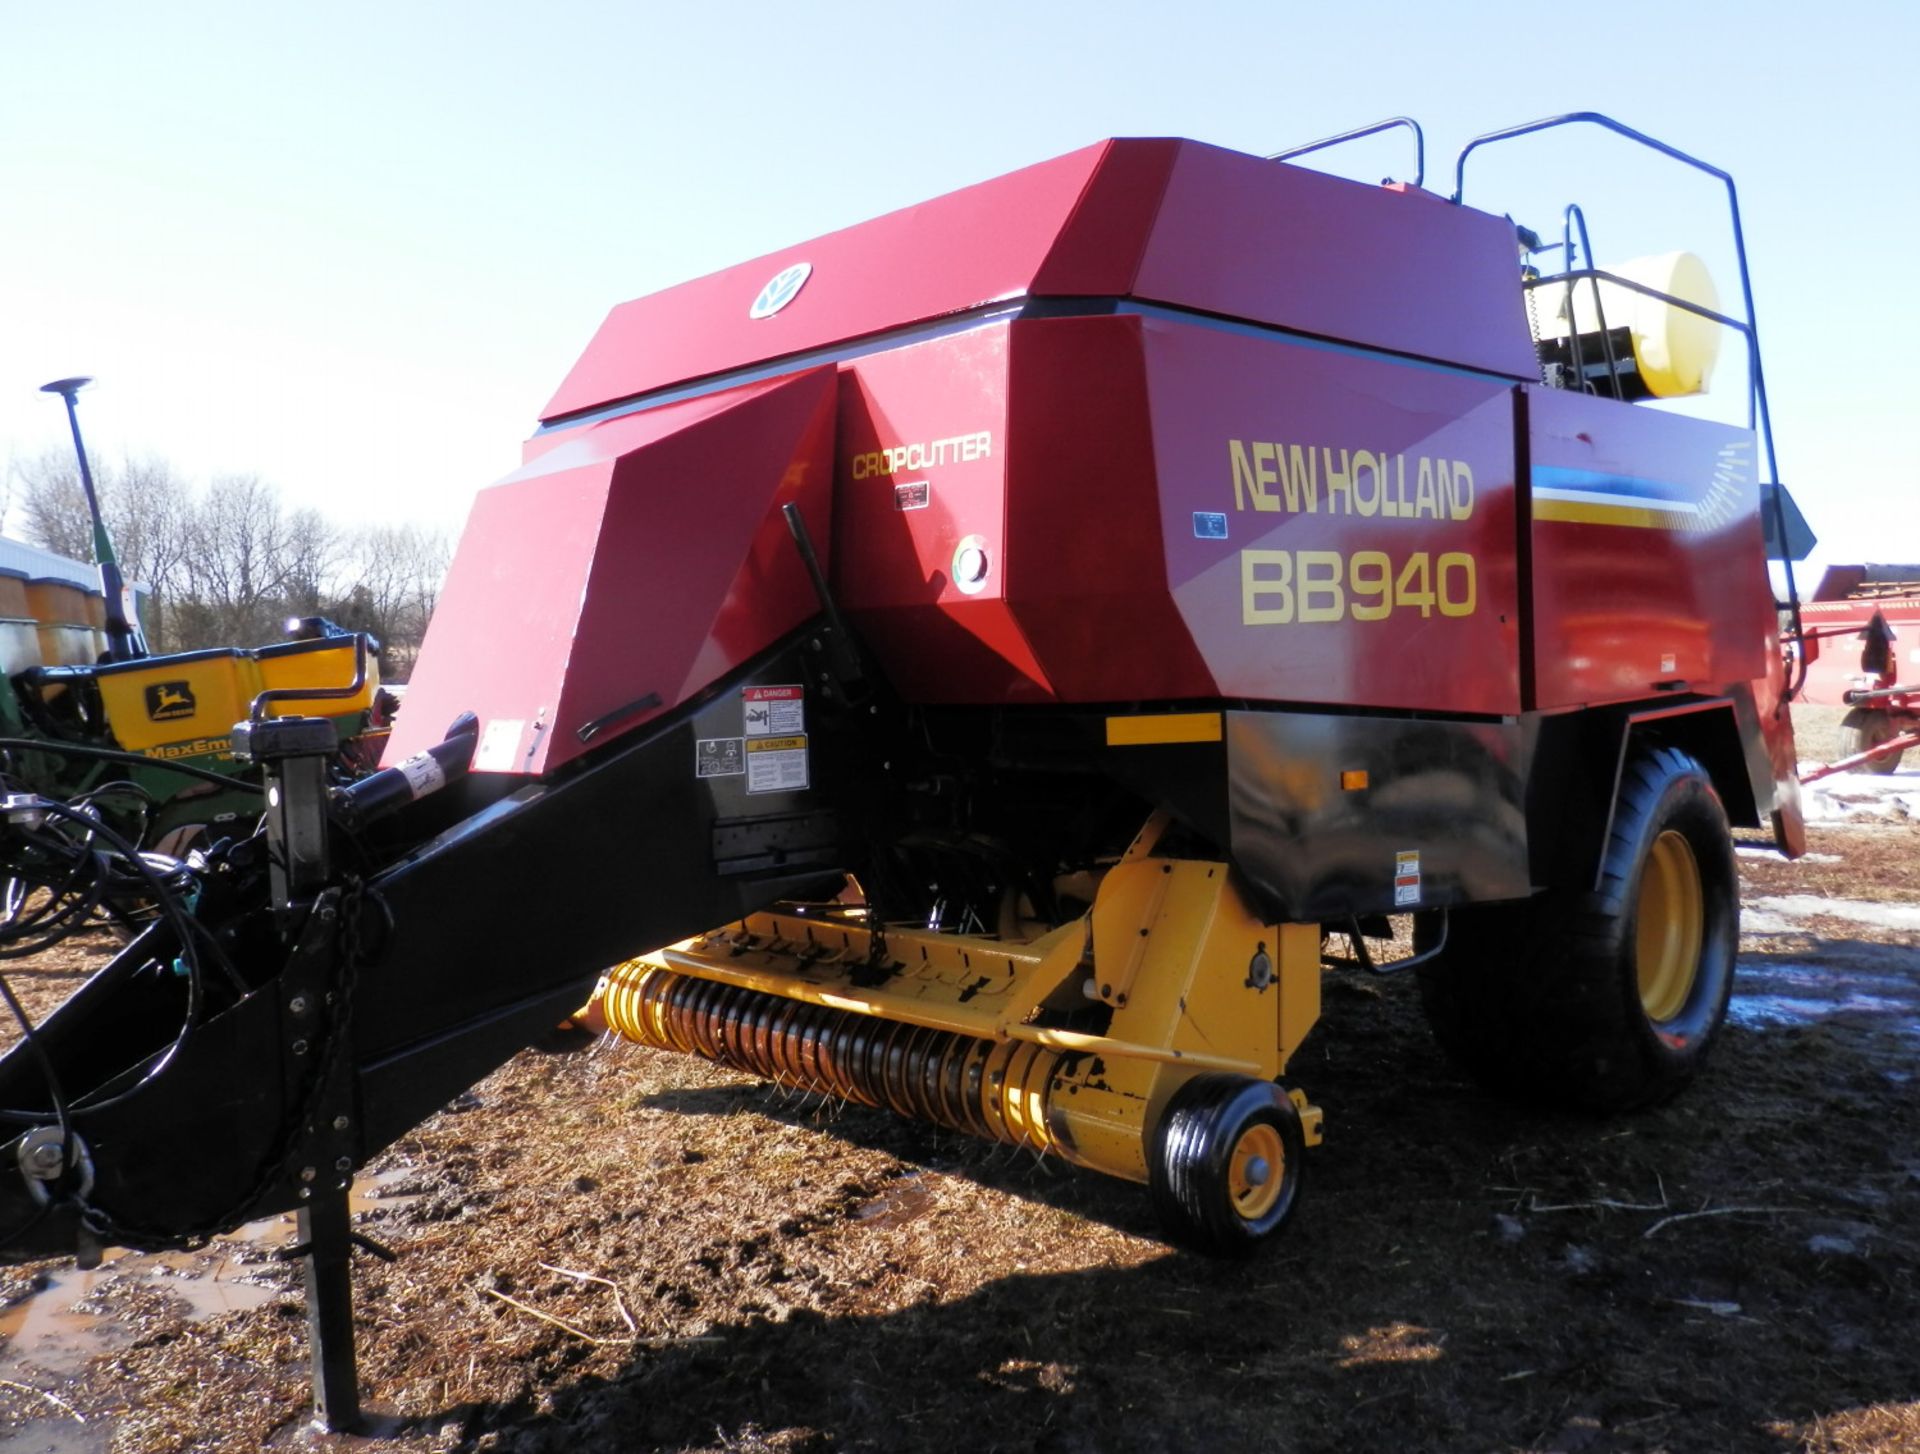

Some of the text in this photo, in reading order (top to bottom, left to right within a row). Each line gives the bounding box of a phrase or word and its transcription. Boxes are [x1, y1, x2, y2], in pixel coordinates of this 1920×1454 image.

[852, 431, 992, 479] CROPCUTTER
[1229, 439, 1474, 521] NEW HOLLAND
[1241, 549, 1477, 625] BB940
[763, 688, 792, 698] DANGER
[144, 739, 233, 759] MaxEm
[765, 739, 798, 748] CAUTION
